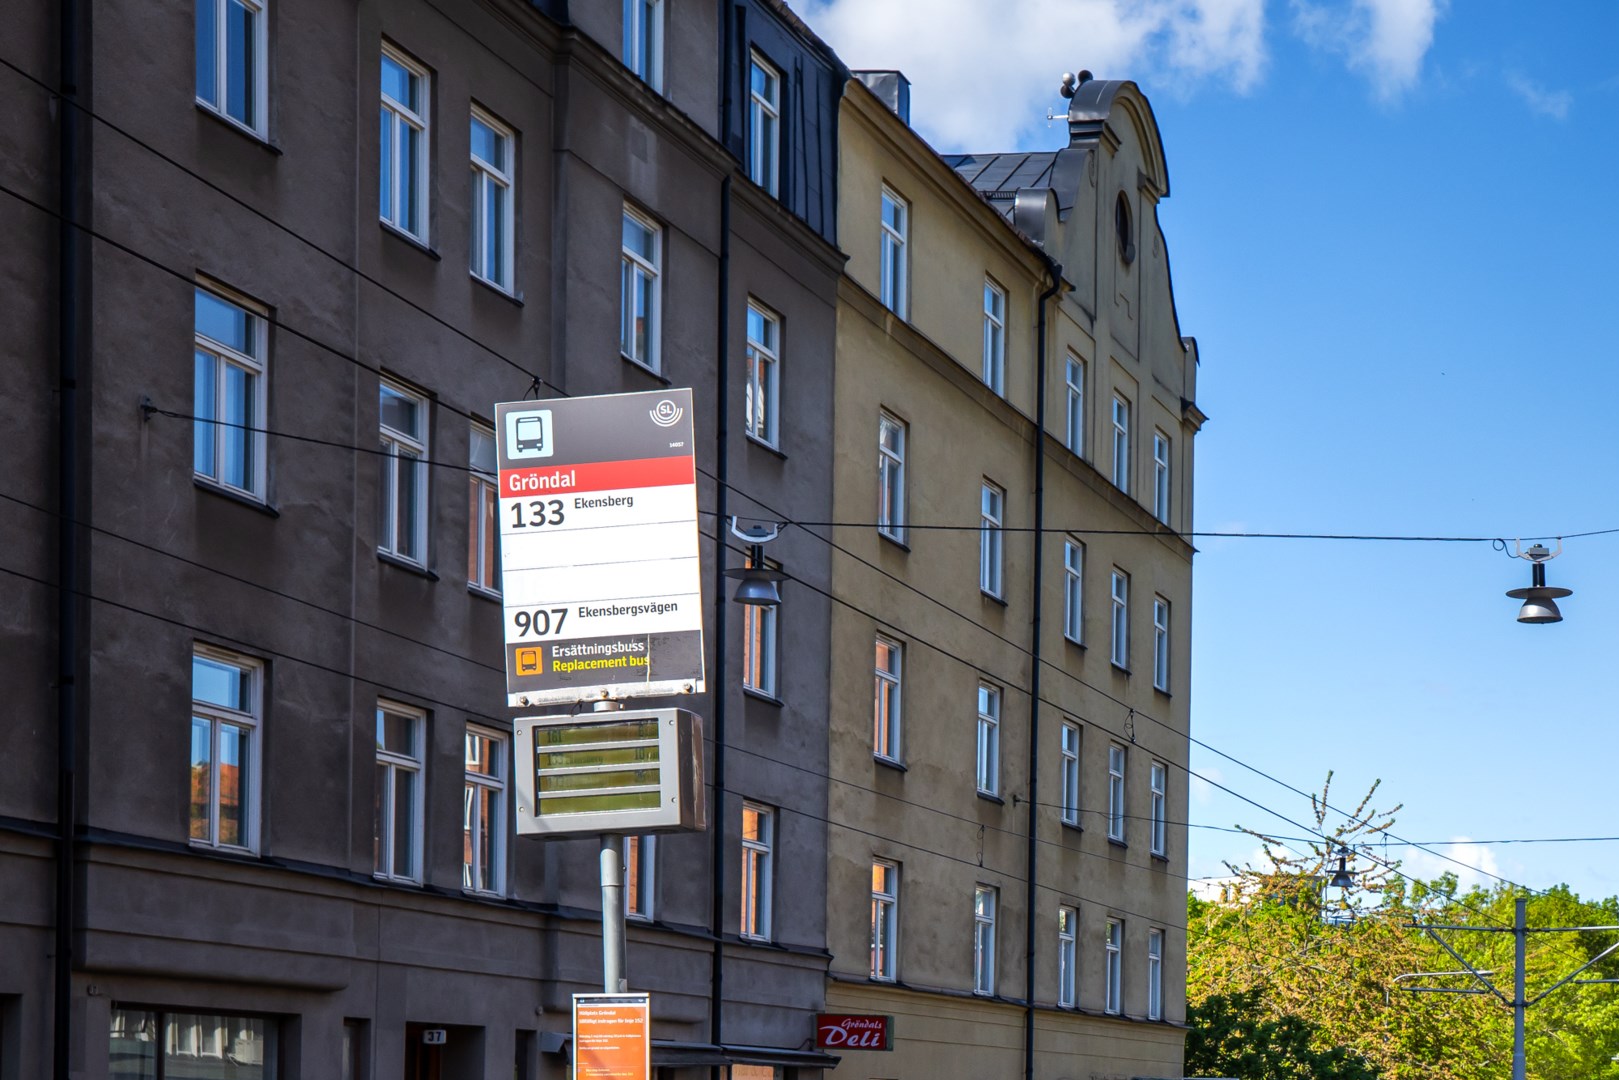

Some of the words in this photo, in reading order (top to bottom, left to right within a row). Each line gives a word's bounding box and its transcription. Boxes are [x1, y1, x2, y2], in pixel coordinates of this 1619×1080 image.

[660, 405, 672, 414] SL
[509, 469, 576, 491] Gröndal
[574, 494, 634, 513] Ekensberg
[510, 499, 565, 529] 133
[578, 600, 678, 619] Ekensbergsvägen
[514, 608, 569, 638] 907
[551, 640, 645, 659] Ersättningsbuss
[552, 656, 627, 673] Replacement
[629, 654, 651, 669] bus
[841, 1018, 883, 1030] Gröndals
[428, 1031, 442, 1042] 37
[819, 1025, 881, 1048] Deli
